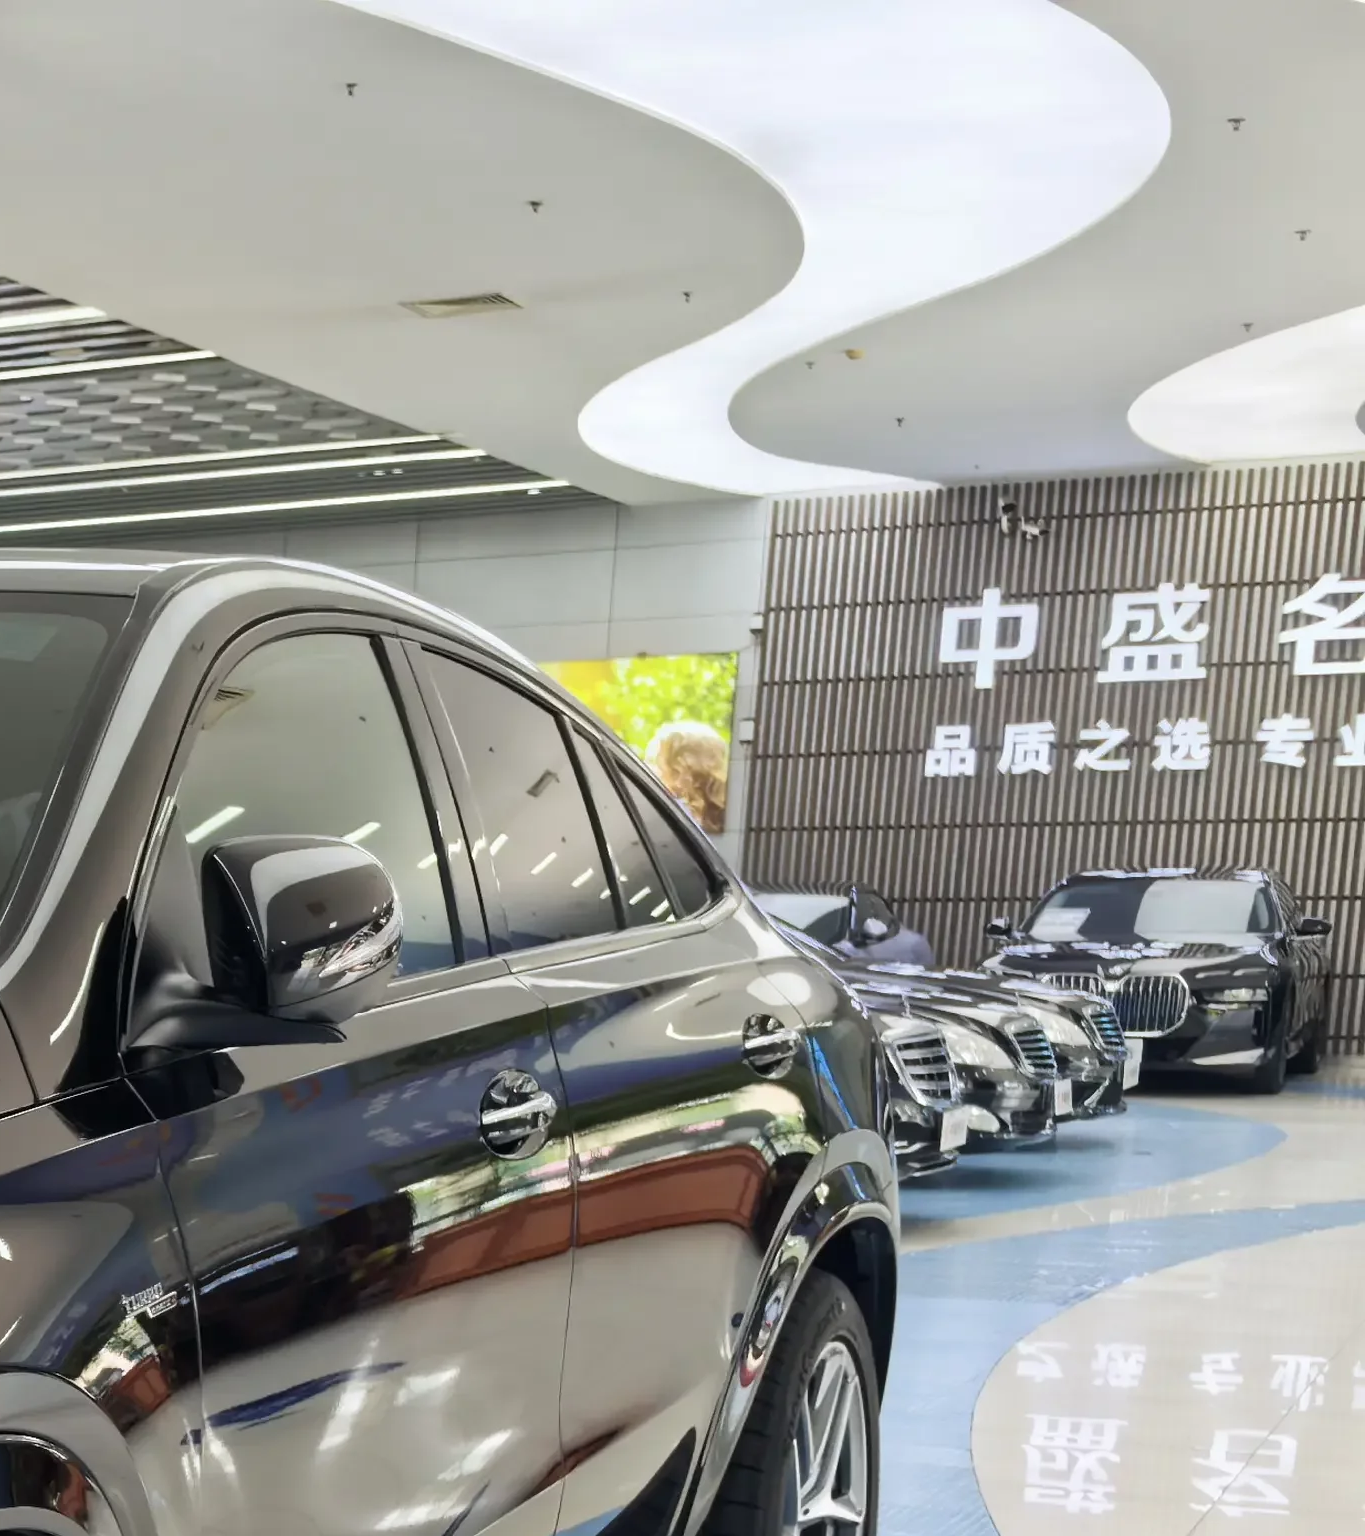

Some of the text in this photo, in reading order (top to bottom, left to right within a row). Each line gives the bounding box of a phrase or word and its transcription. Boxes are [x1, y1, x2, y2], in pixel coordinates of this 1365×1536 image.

[939, 573, 1365, 689] 中盛名
[924, 718, 1210, 778] 品质之选
